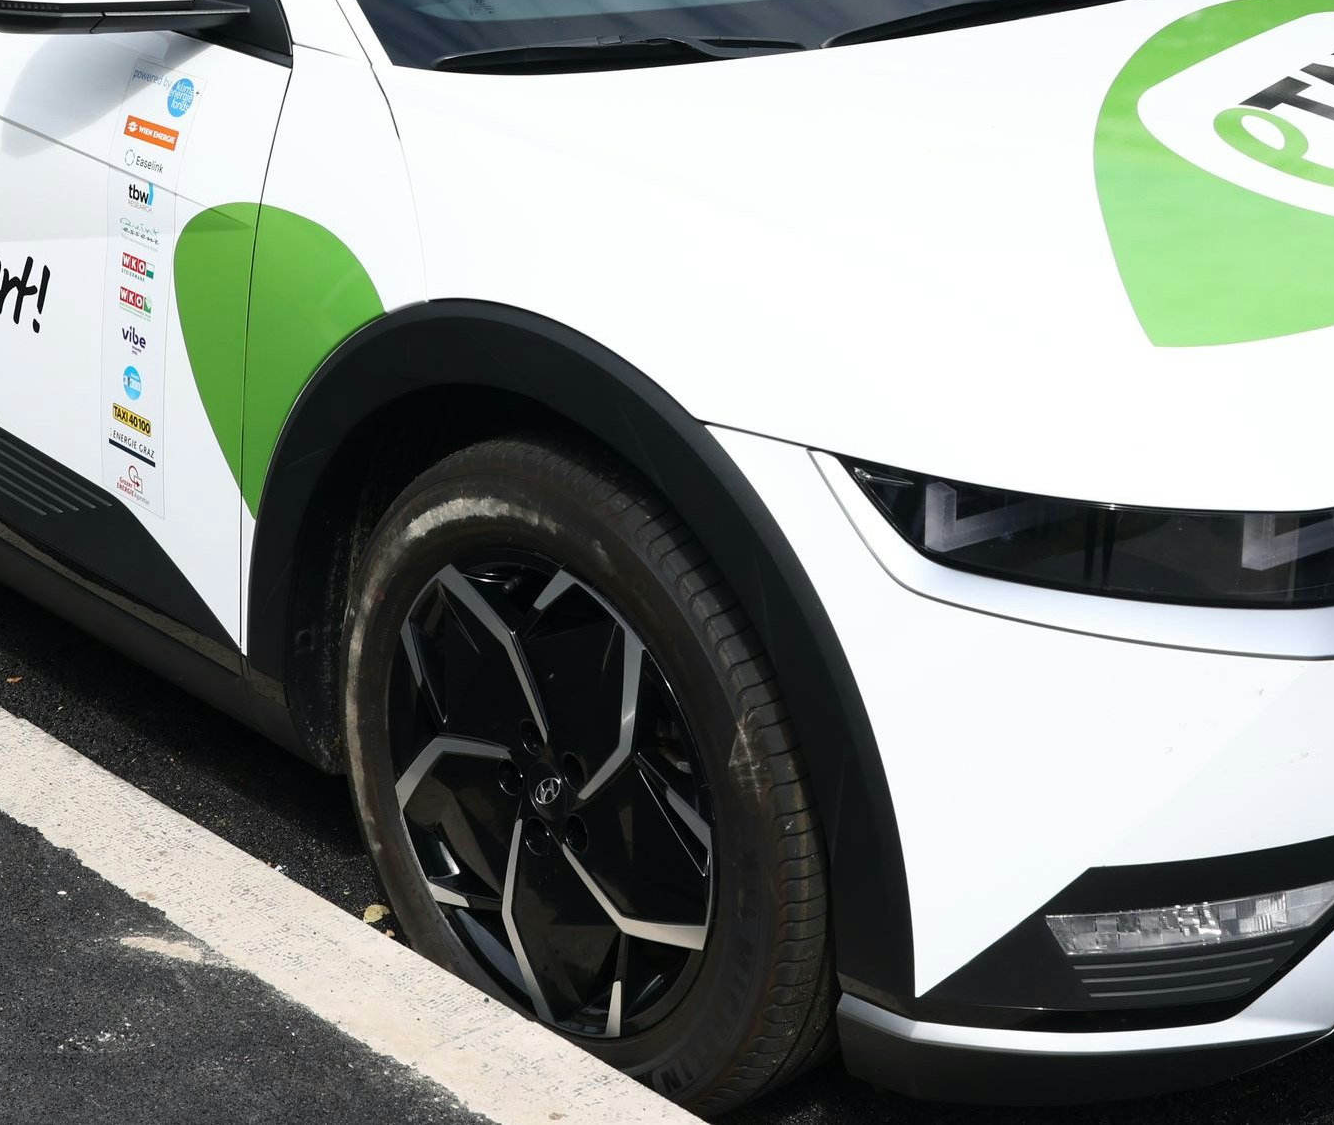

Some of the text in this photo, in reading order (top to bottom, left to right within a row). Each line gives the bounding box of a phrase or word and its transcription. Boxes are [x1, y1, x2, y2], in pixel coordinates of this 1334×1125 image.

[132, 69, 162, 85] powered
[138, 125, 154, 136] WIEN
[135, 155, 164, 174] Easelink
[128, 184, 149, 205] tbw
[122, 254, 145, 274] WKO
[120, 288, 143, 307] WKO
[122, 325, 146, 349] vibe
[113, 405, 129, 423] TAXI
[128, 416, 139, 428] 40
[112, 430, 155, 459] ENERGIE GRAZ
